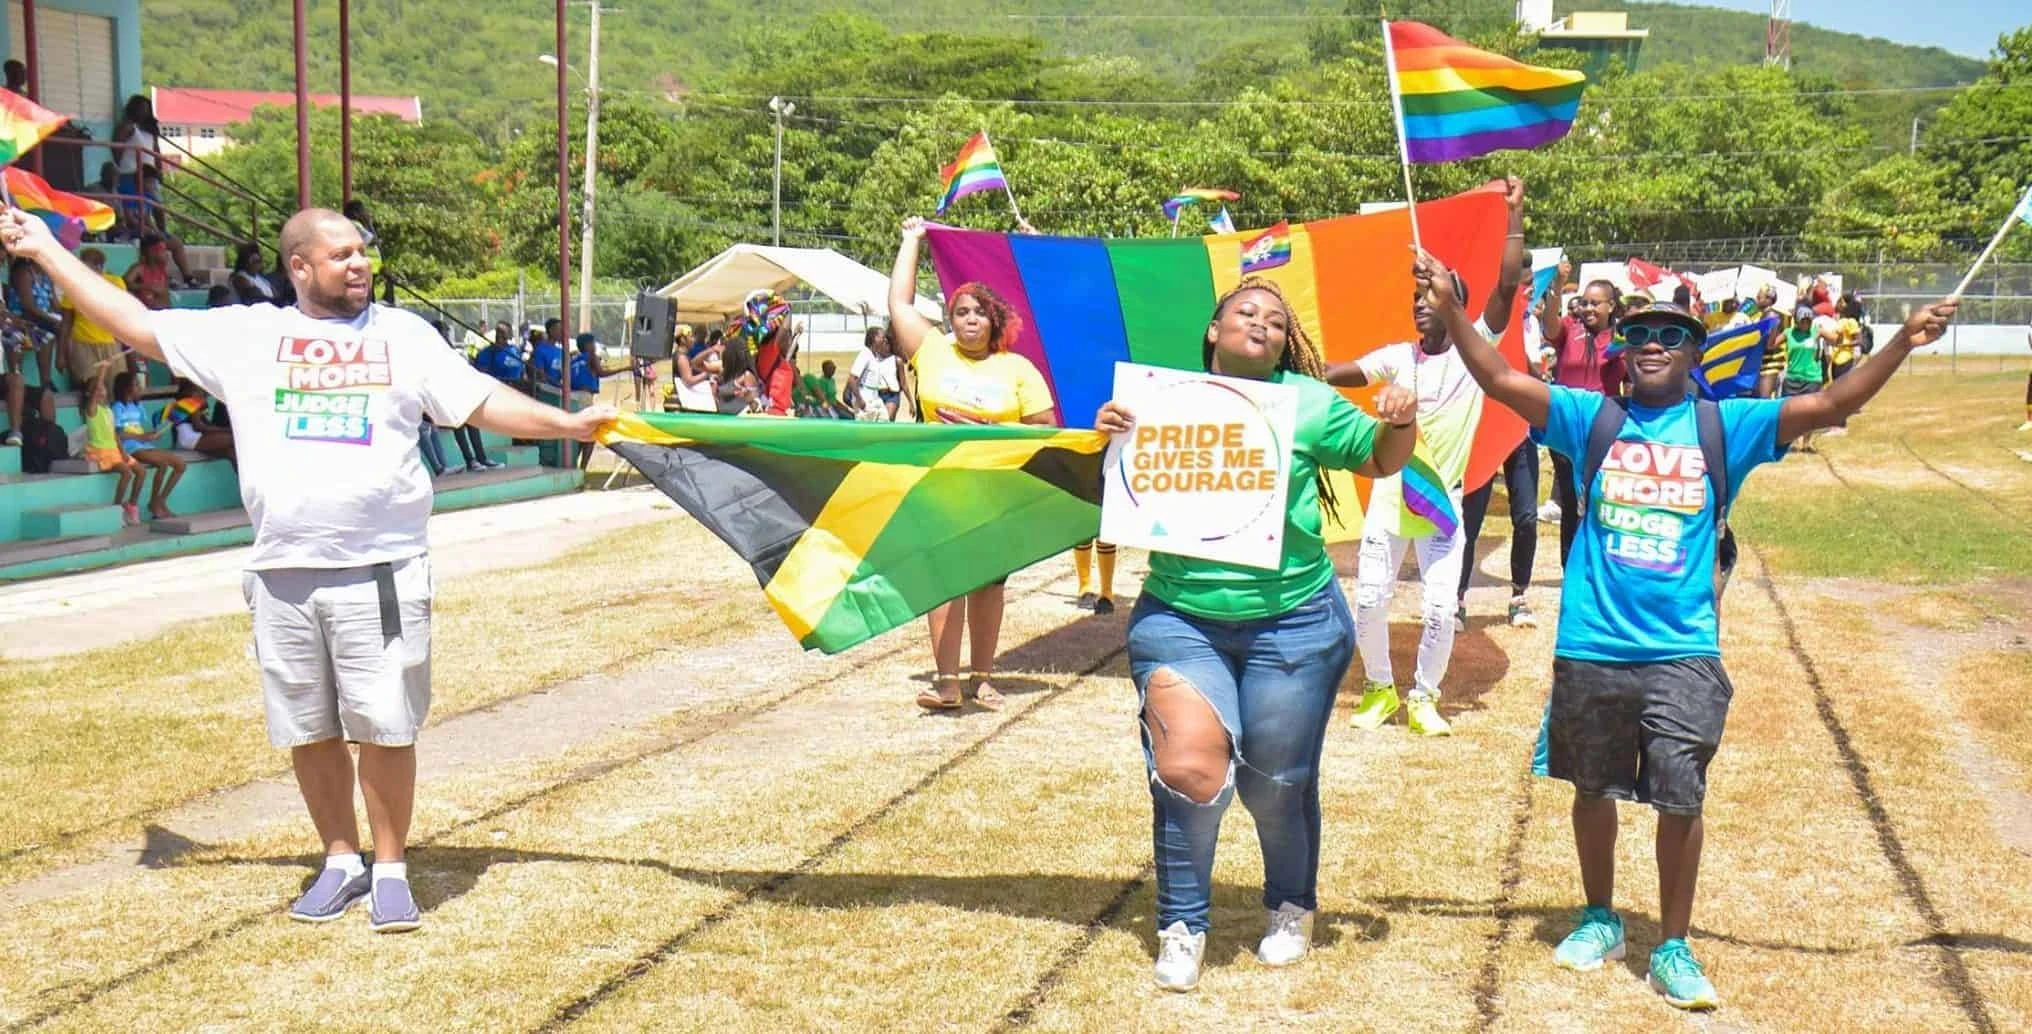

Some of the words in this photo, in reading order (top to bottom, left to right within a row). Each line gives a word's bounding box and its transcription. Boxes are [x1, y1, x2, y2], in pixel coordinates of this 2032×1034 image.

[277, 336, 388, 364] LOVE
[291, 363, 391, 390] MORE
[276, 391, 368, 414] JUDGE
[287, 416, 367, 439] LESS
[1135, 423, 1245, 449] PRIDE
[1133, 450, 1214, 471] GIVES
[1223, 448, 1265, 468] ME
[1601, 442, 1706, 478] LOVE
[1131, 469, 1276, 493] COURAGE
[1604, 474, 1705, 506] MORE
[1606, 533, 1678, 563] LESS
